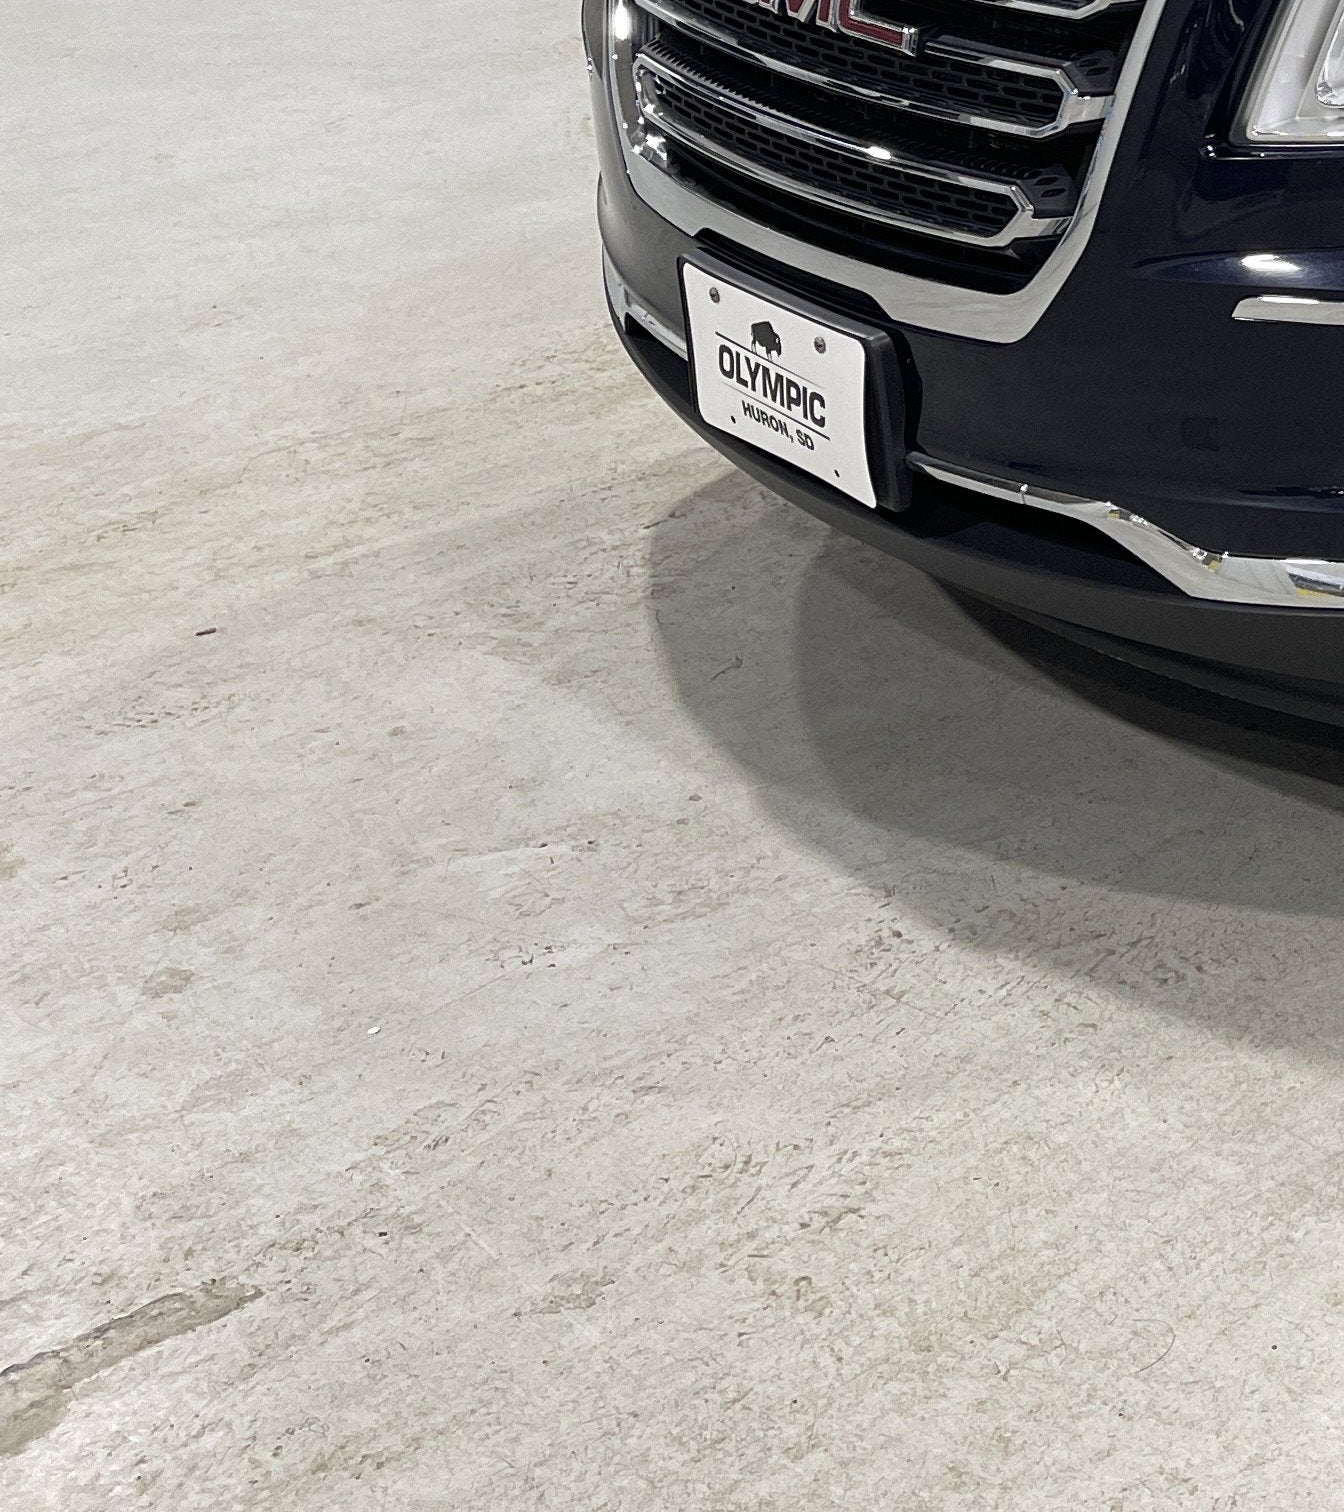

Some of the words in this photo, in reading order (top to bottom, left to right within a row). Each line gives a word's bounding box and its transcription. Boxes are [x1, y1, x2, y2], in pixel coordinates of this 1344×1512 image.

[718, 343, 826, 429] OLYMPIC
[741, 399, 795, 444] HURON,
[796, 429, 815, 451] SD
